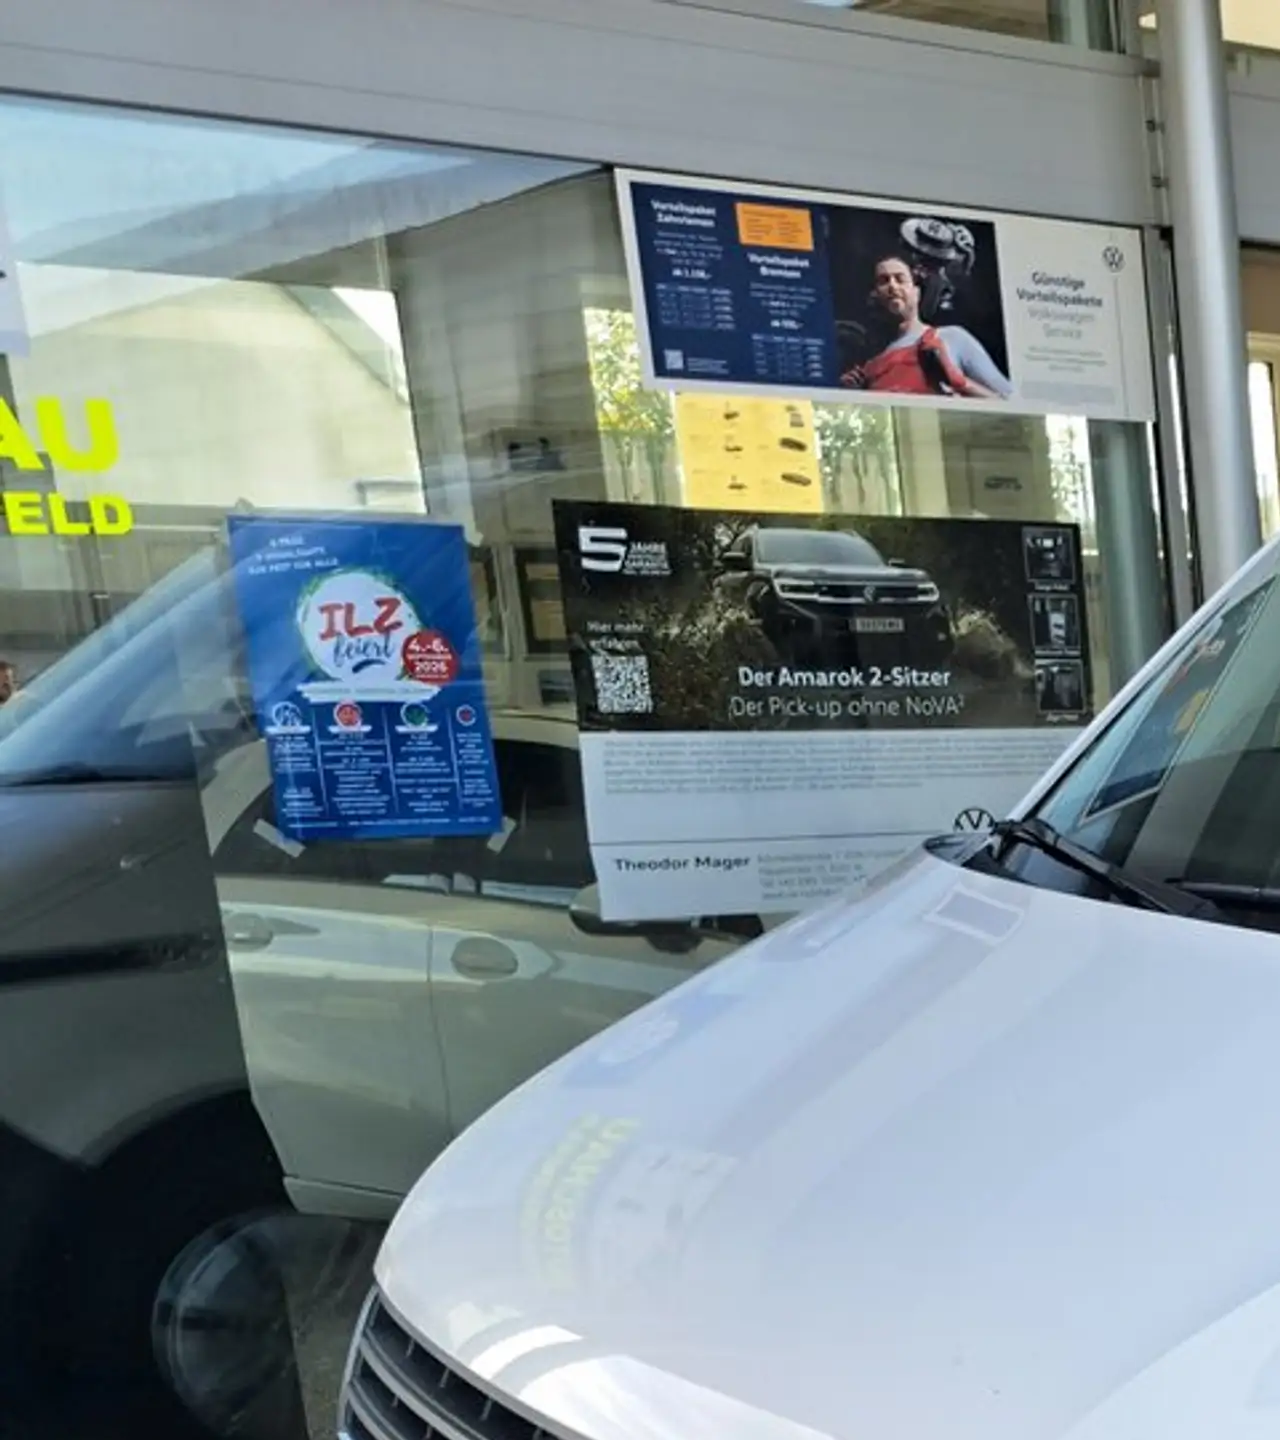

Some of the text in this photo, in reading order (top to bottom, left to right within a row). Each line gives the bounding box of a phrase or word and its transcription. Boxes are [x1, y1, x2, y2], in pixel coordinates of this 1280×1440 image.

[578, 526, 628, 572] 5
[318, 597, 403, 641] ILZ
[333, 631, 393, 667] feiert
[738, 666, 952, 687] Der Amarok 2-Sitzer
[732, 698, 764, 716] Der
[770, 698, 842, 719] Pick-up
[849, 697, 900, 716] ohne
[616, 856, 751, 873] Theodor Mager
